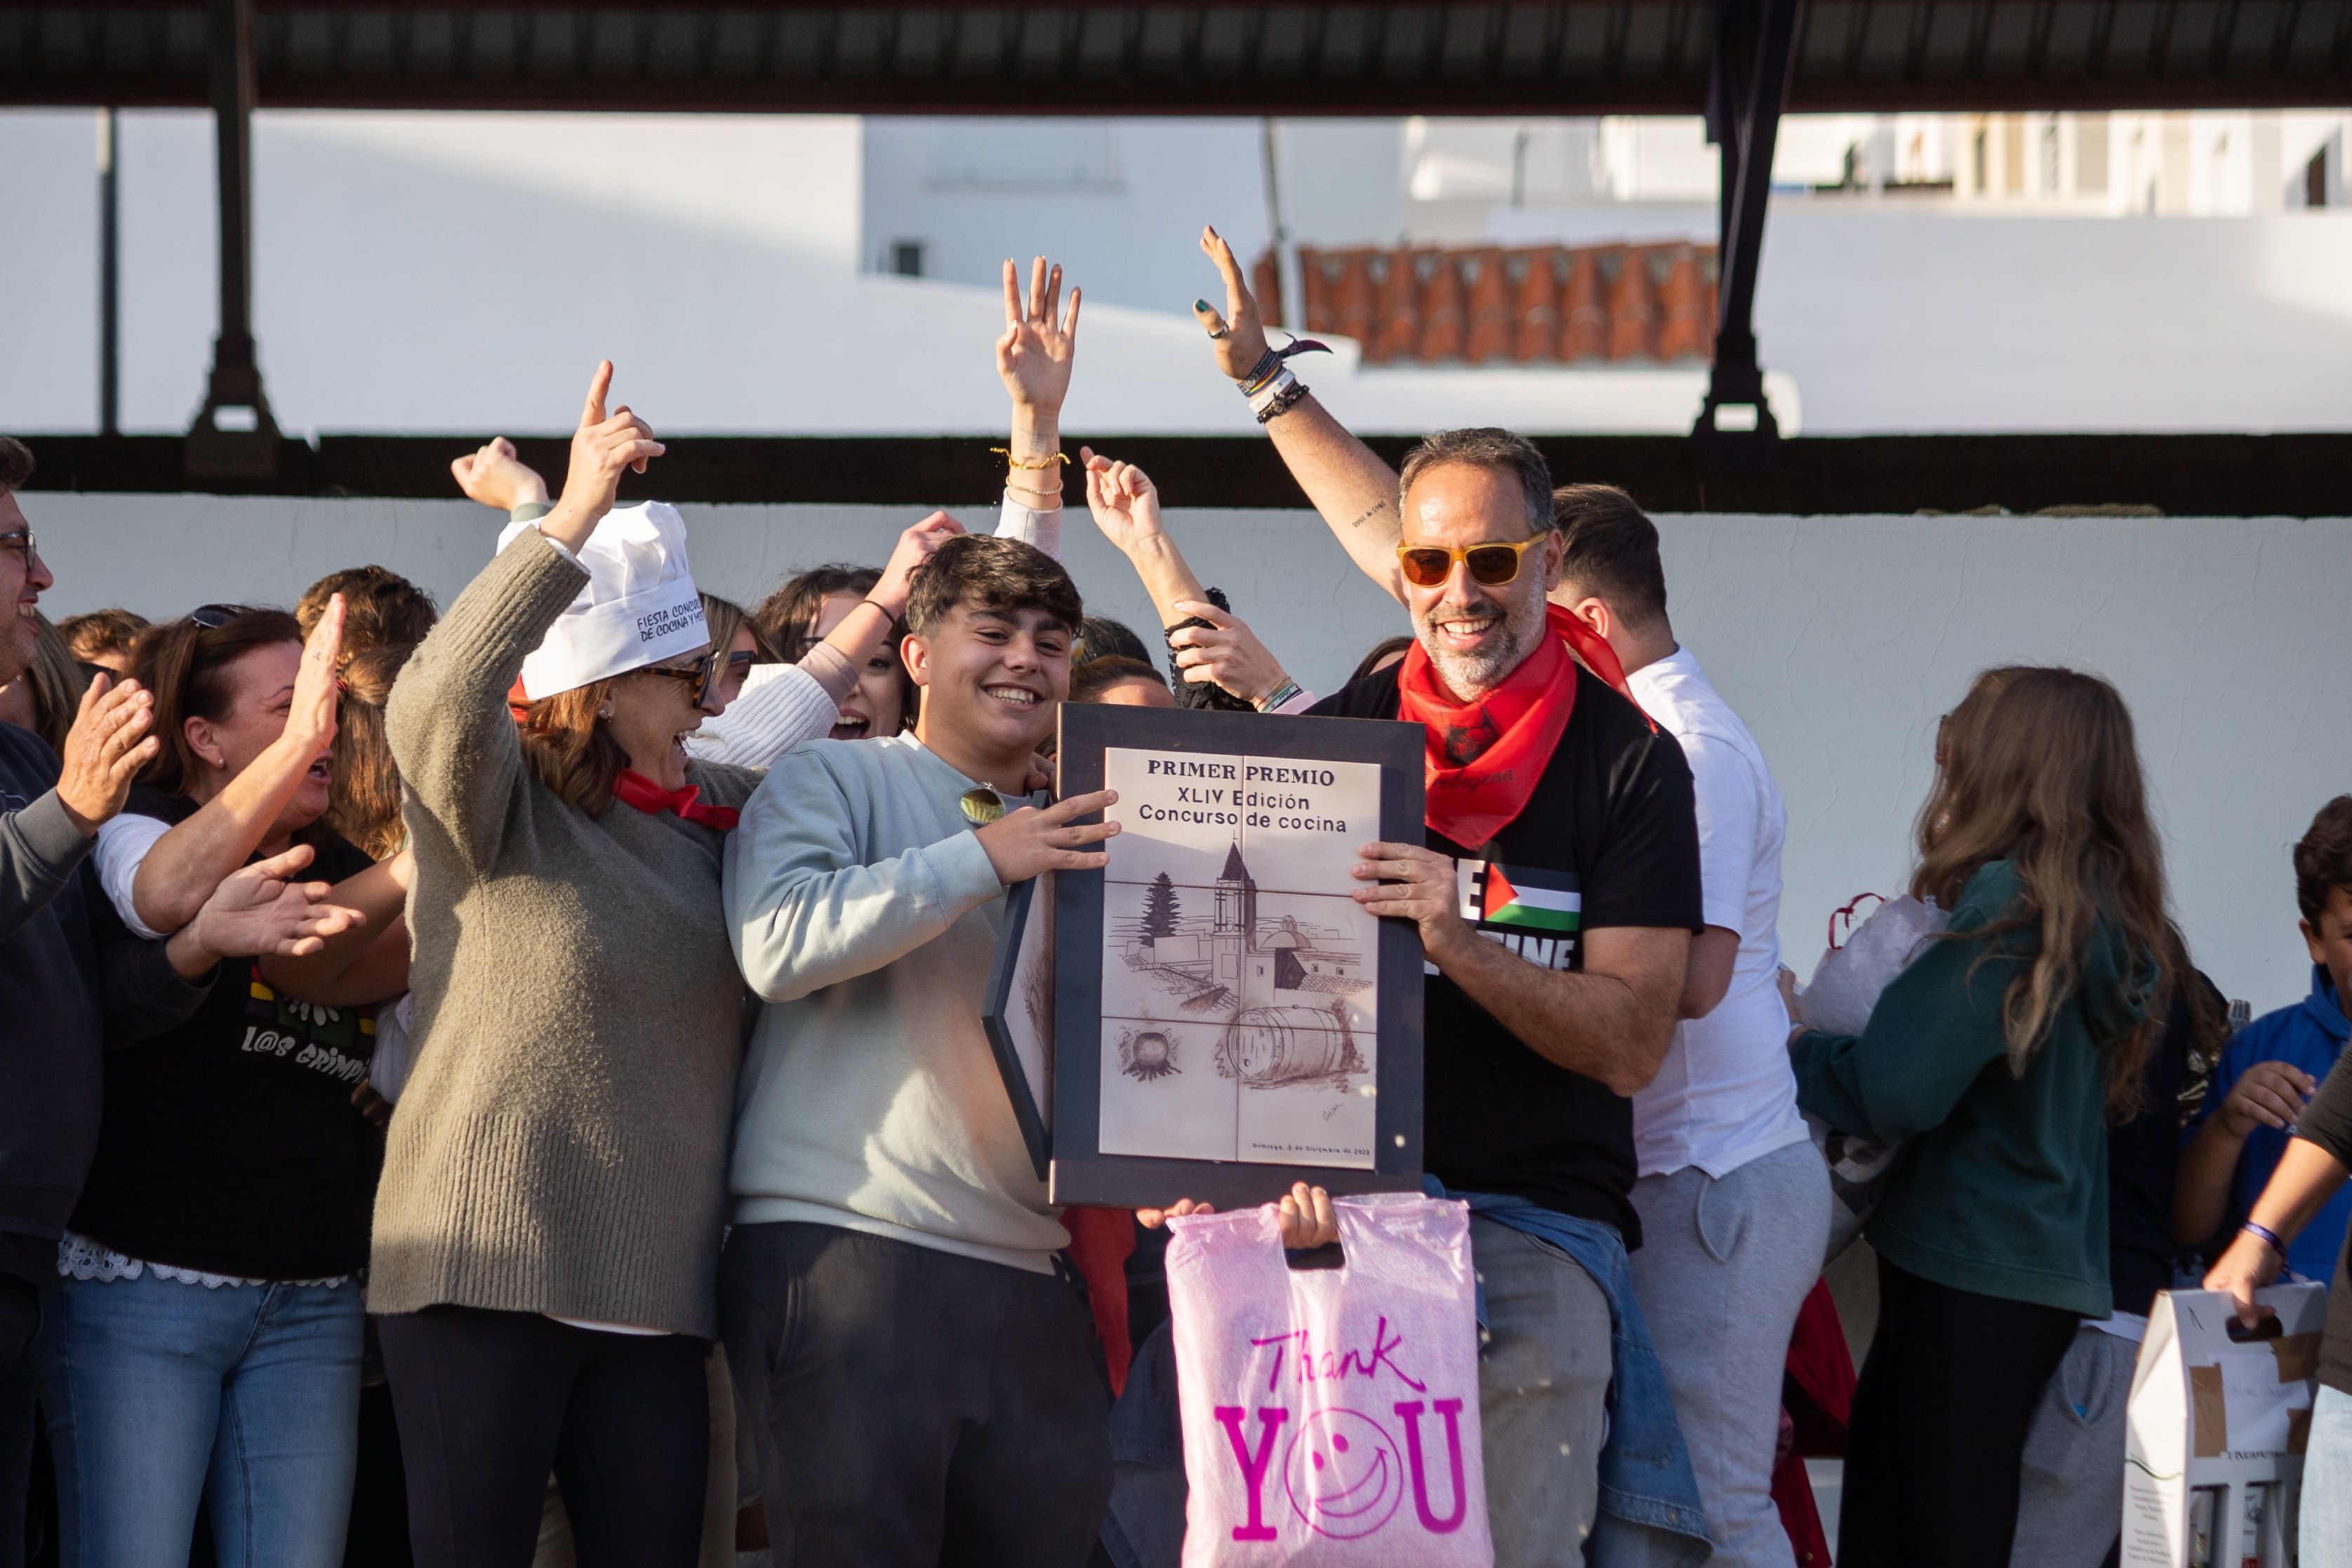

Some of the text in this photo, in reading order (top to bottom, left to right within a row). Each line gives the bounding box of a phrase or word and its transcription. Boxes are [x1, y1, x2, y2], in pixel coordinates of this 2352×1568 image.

[637, 609, 669, 630] FIESTA
[640, 627, 653, 642] DE
[656, 616, 689, 637] COCINA
[689, 614, 694, 625] Y
[1148, 759, 1335, 786] PRIMER PREMIO
[1178, 787, 1310, 810] XLIV Edición
[1139, 804, 1346, 832] Concurso de cocina
[1250, 1316, 1426, 1393] Thank
